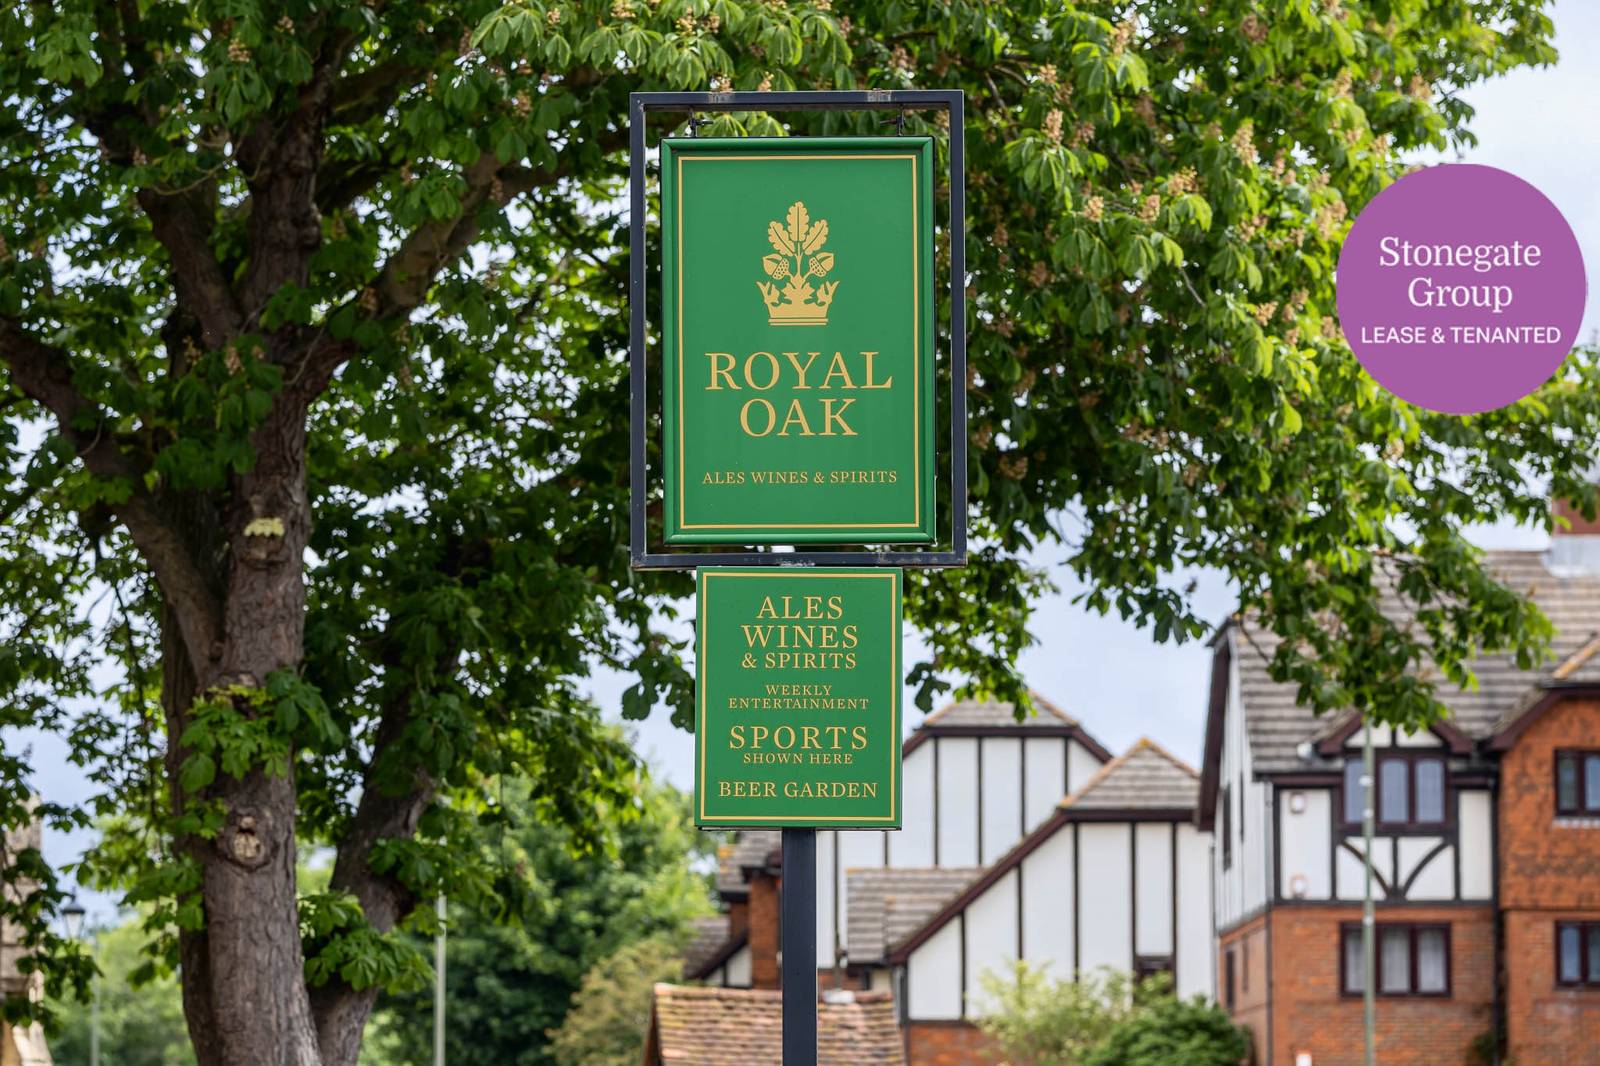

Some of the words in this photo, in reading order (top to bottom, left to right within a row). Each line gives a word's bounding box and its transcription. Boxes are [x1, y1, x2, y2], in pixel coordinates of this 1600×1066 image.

[704, 351, 894, 390] ROYAL
[739, 398, 859, 437] OAK
[702, 471, 745, 484] ALES
[751, 471, 808, 484] WINES
[813, 471, 825, 484] &
[830, 470, 898, 484] SPIRITS
[756, 596, 844, 620] ALES
[741, 624, 859, 649] WINES
[741, 652, 757, 669] &
[765, 652, 857, 670] SPIRITS
[765, 684, 833, 696] WEEKLY
[728, 698, 869, 710] ENTERTAINMENT
[729, 725, 868, 750] SPORTS
[743, 752, 803, 764] SHOWN
[810, 753, 854, 764] HERE
[718, 781, 777, 797] BEER
[783, 782, 878, 798] GARDEN
